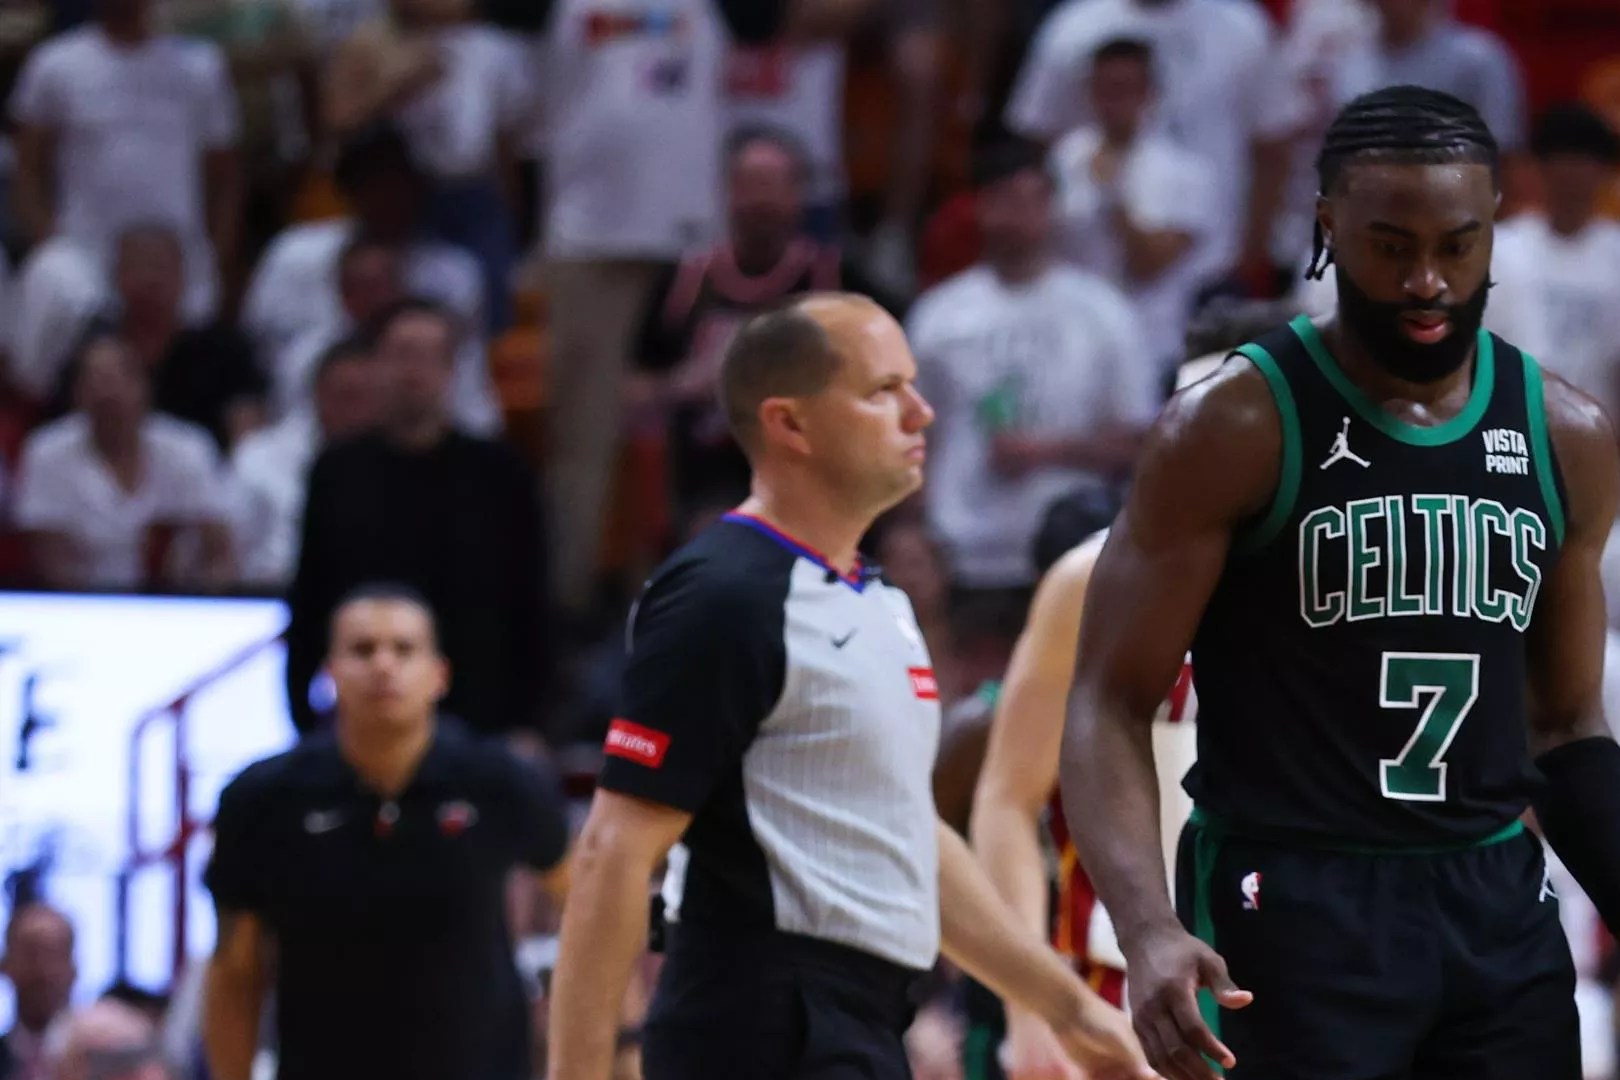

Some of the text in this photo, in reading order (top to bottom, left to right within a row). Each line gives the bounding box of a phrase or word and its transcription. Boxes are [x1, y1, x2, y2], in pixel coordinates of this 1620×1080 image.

[1482, 428, 1529, 457] VISTA
[1485, 454, 1529, 475] PRINT
[1300, 494, 1546, 632] CELTICS
[1379, 651, 1480, 801] 7
